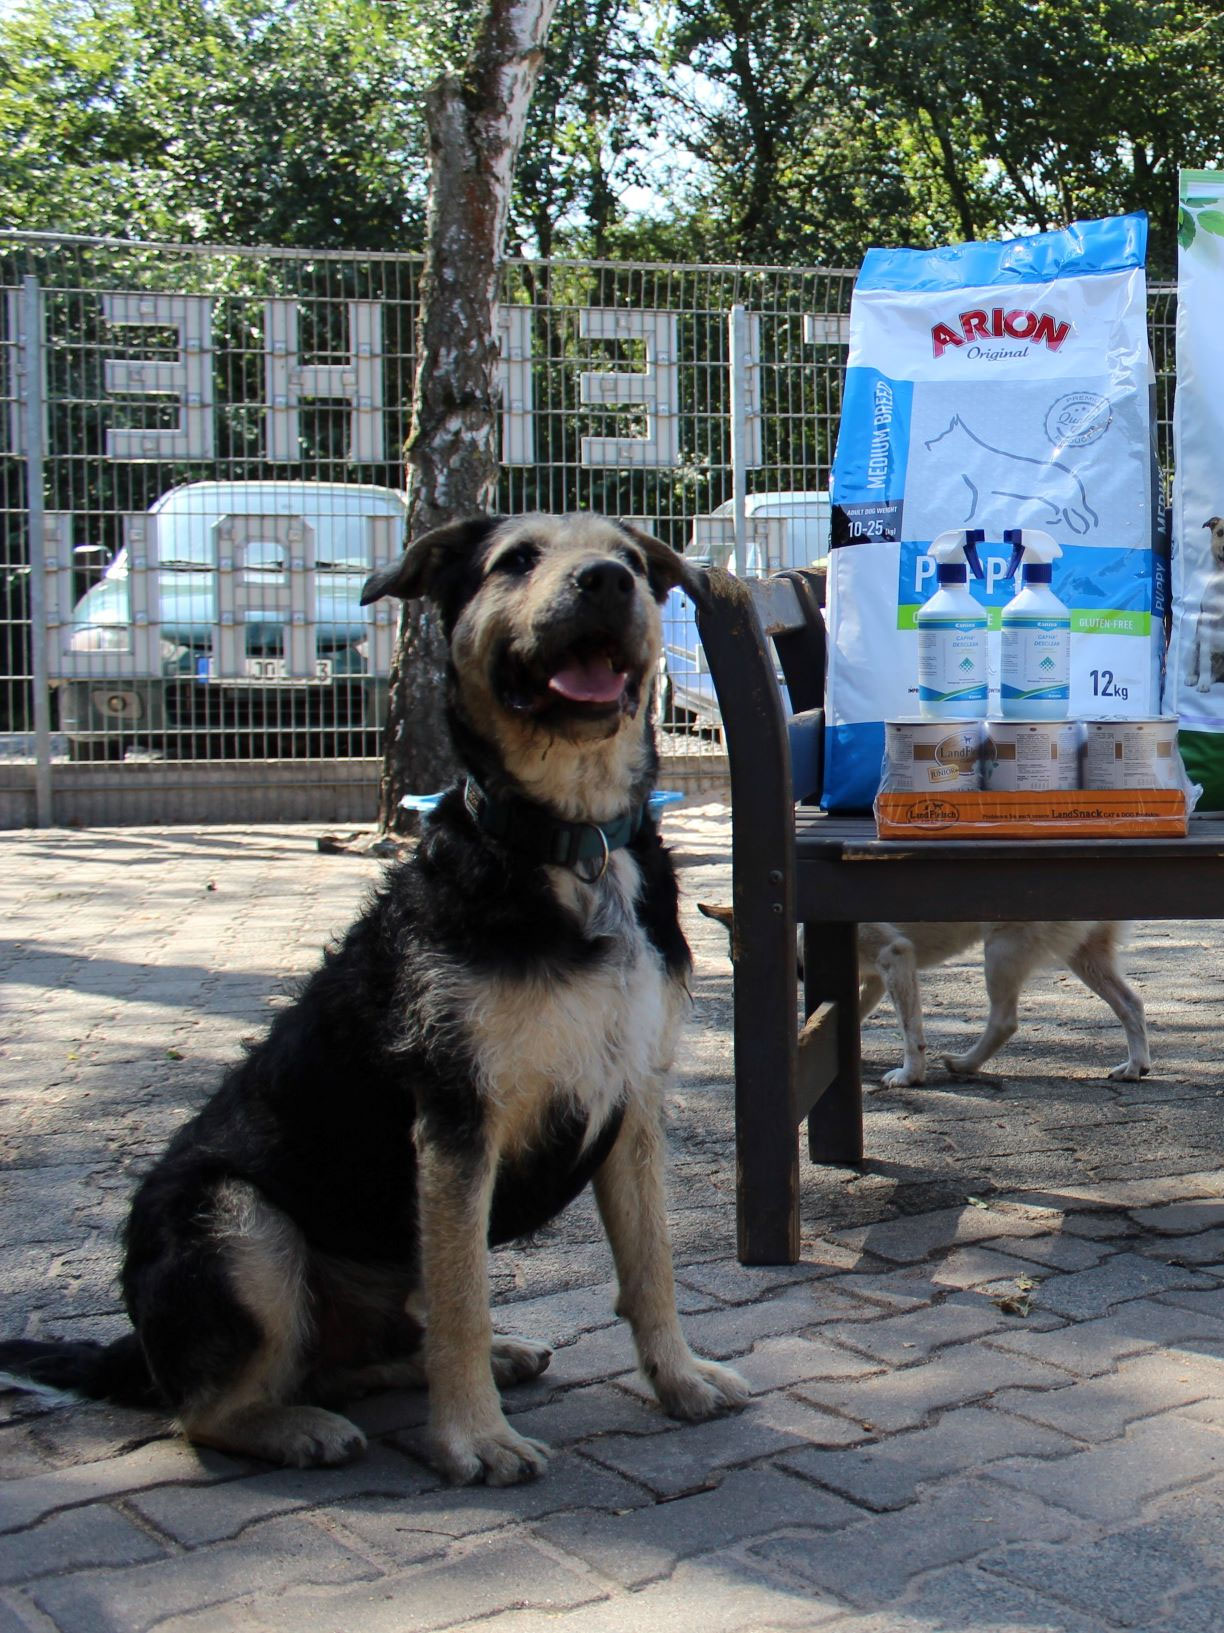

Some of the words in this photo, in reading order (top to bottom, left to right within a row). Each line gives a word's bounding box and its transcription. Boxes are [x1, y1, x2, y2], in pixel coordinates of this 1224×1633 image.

[931, 307, 1071, 359] ARION
[967, 346, 1029, 361] Original
[875, 381, 893, 424] BREED
[867, 426, 890, 489] MEDIUM
[876, 506, 898, 514] WEIGHT
[848, 519, 883, 538] 10-25
[1155, 562, 1166, 611] PUPPY
[1079, 618, 1134, 630] GLUTEN-FREE
[910, 809, 957, 820] LandFleisch
[1051, 809, 1103, 819] LandSnack
